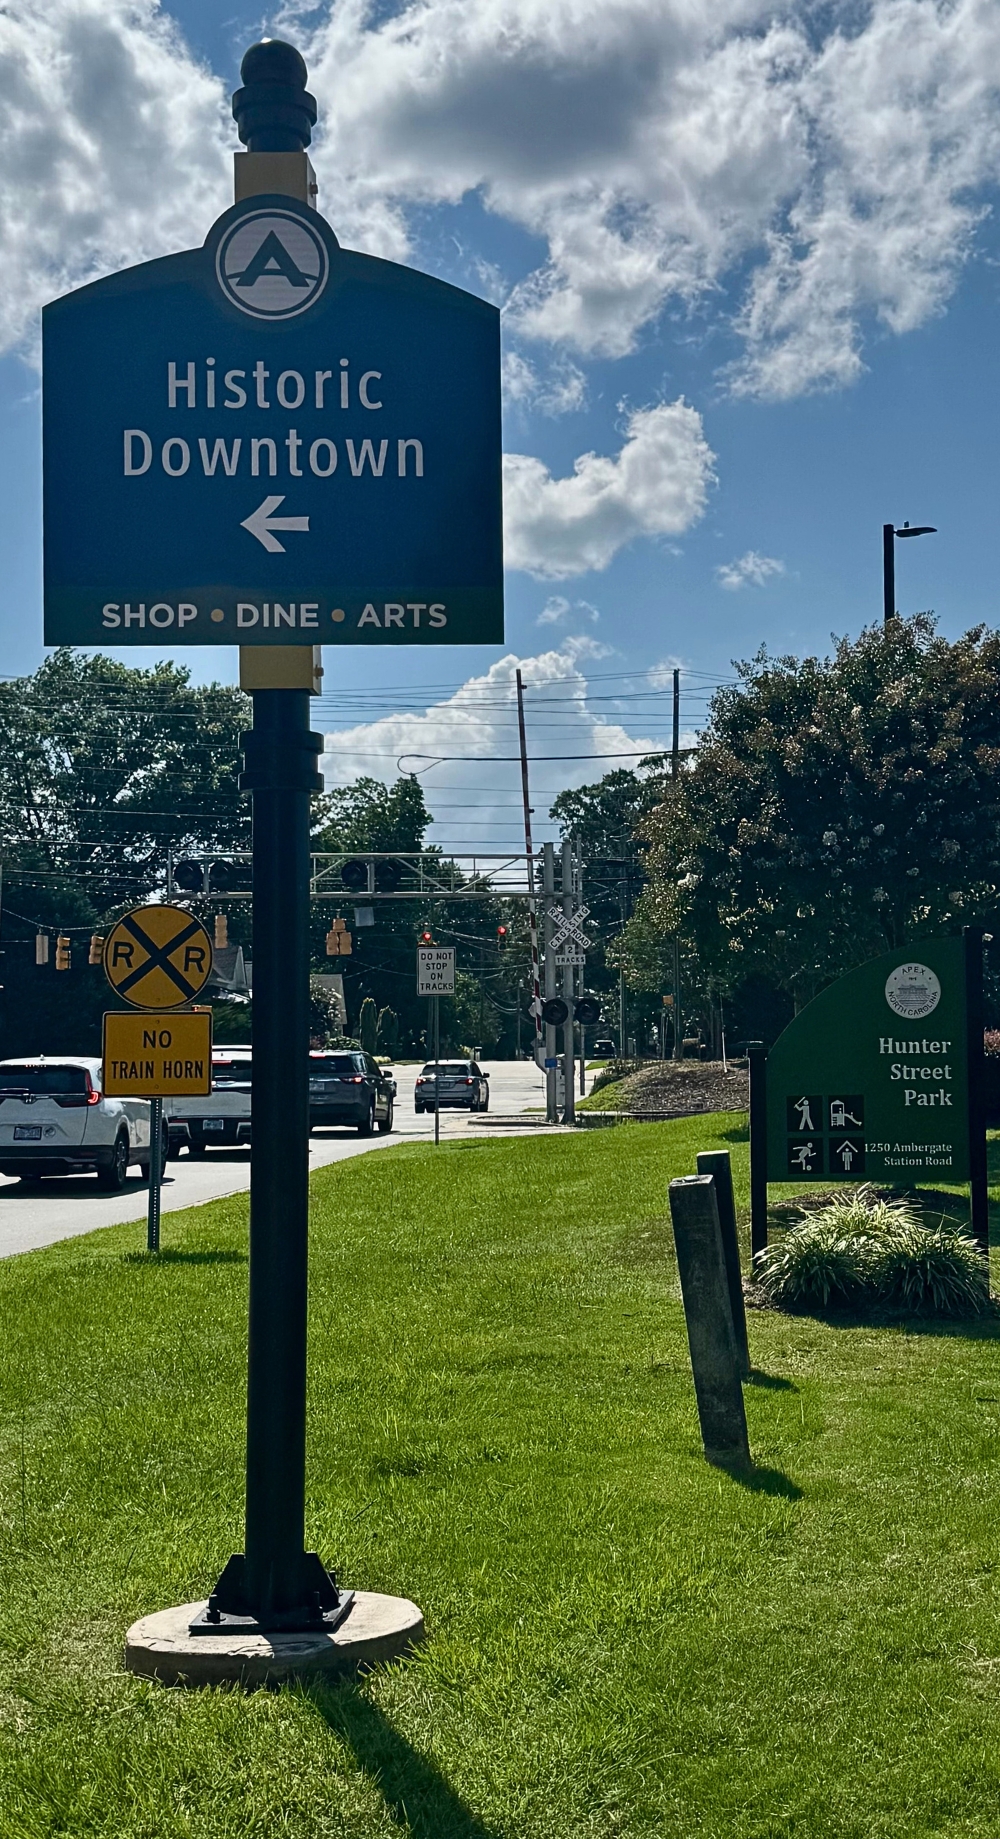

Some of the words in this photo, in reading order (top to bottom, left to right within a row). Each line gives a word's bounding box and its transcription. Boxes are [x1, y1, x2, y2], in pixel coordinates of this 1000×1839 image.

[167, 357, 384, 410] Historic
[123, 429, 425, 478] Downtown
[101, 603, 199, 629] SHOP
[236, 603, 320, 629] DINE
[357, 603, 448, 629] ARTS
[550, 907, 589, 948] CROSSING
[112, 941, 135, 969] R
[183, 946, 206, 973] R
[420, 952, 433, 961] DO
[436, 952, 452, 961] NOT
[567, 946, 574, 954] 2
[425, 962, 448, 971] STOP
[902, 966, 926, 976] APEX
[430, 972, 443, 981] ON
[420, 982, 454, 991] TRACKS
[888, 990, 907, 1014] NORTH
[907, 990, 938, 1016] CAROLINA
[142, 1030, 172, 1049] NO
[878, 1037, 952, 1055] Hunter
[111, 1060, 154, 1080] TRAIN
[162, 1060, 204, 1080] HORN
[889, 1063, 953, 1081] Street
[903, 1089, 953, 1107] Park
[864, 1143, 891, 1153] 1250
[893, 1142, 953, 1155] Ambergate
[884, 1156, 922, 1166] Station
[925, 1156, 953, 1166] Road
